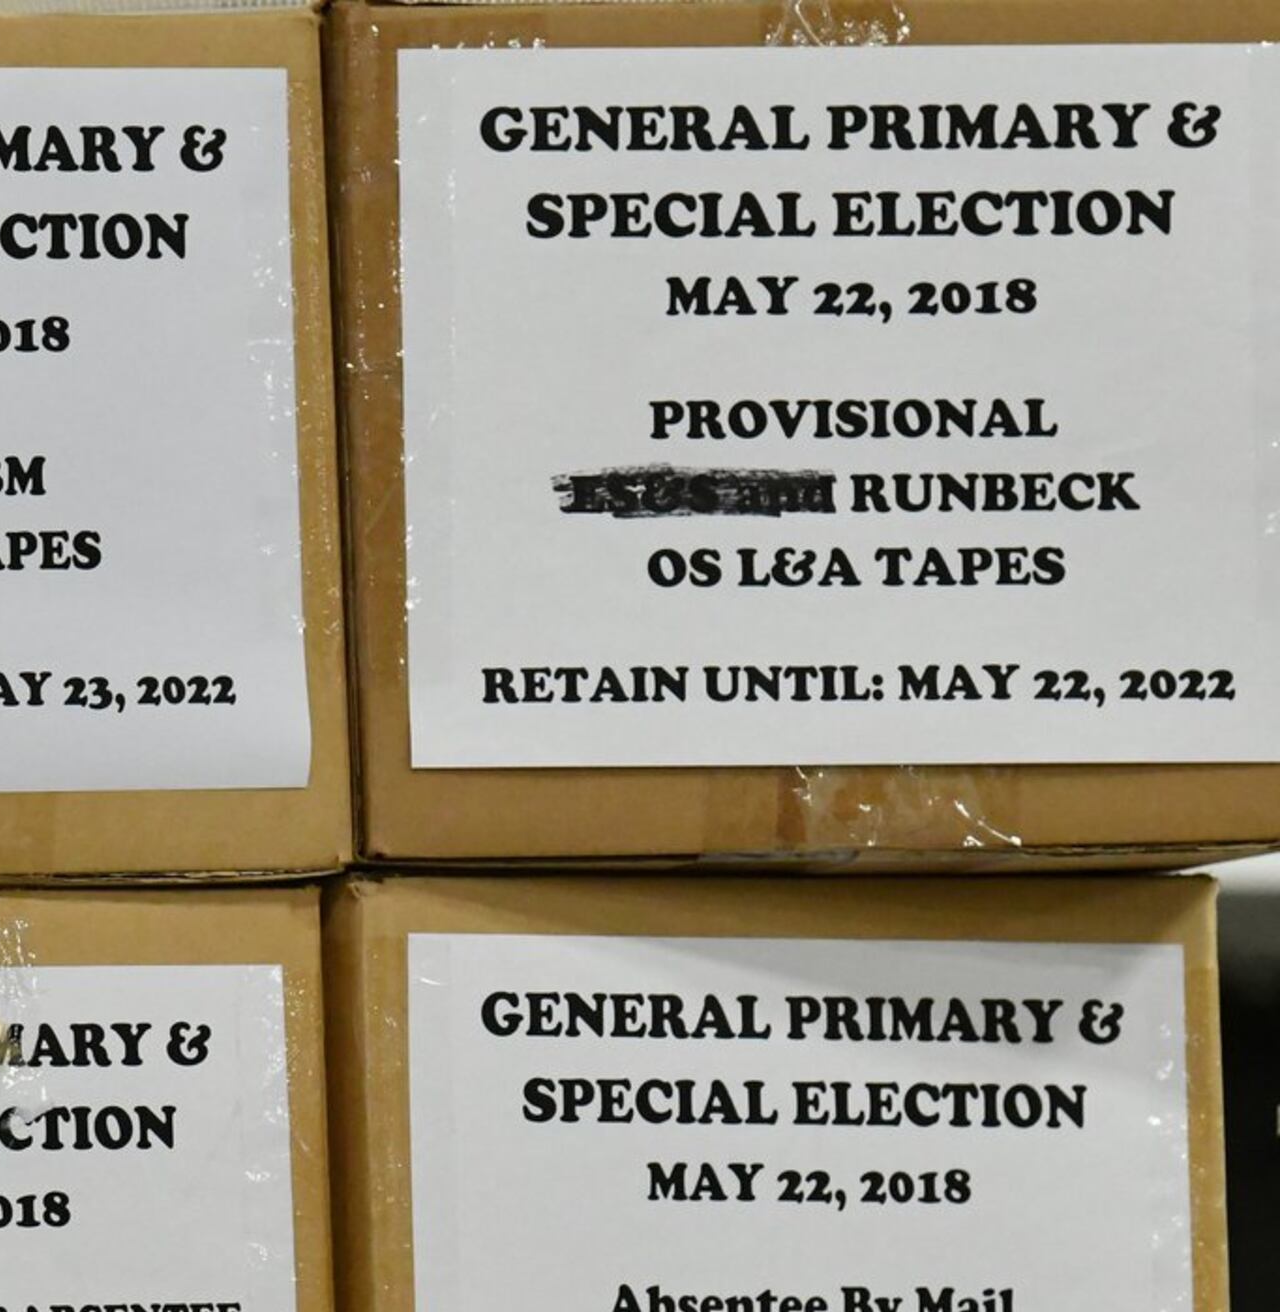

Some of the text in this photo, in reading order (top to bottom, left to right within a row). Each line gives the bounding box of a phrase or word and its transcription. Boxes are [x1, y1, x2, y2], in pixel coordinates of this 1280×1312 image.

[480, 102, 1221, 152] GENERAL PRIMARY &
[649, 399, 1058, 439] PROVISIONAL
[850, 472, 1140, 513] RUNBECK
[648, 547, 1065, 587] OS L&A TAPES
[647, 1162, 971, 1211] MAY 22, 2018
